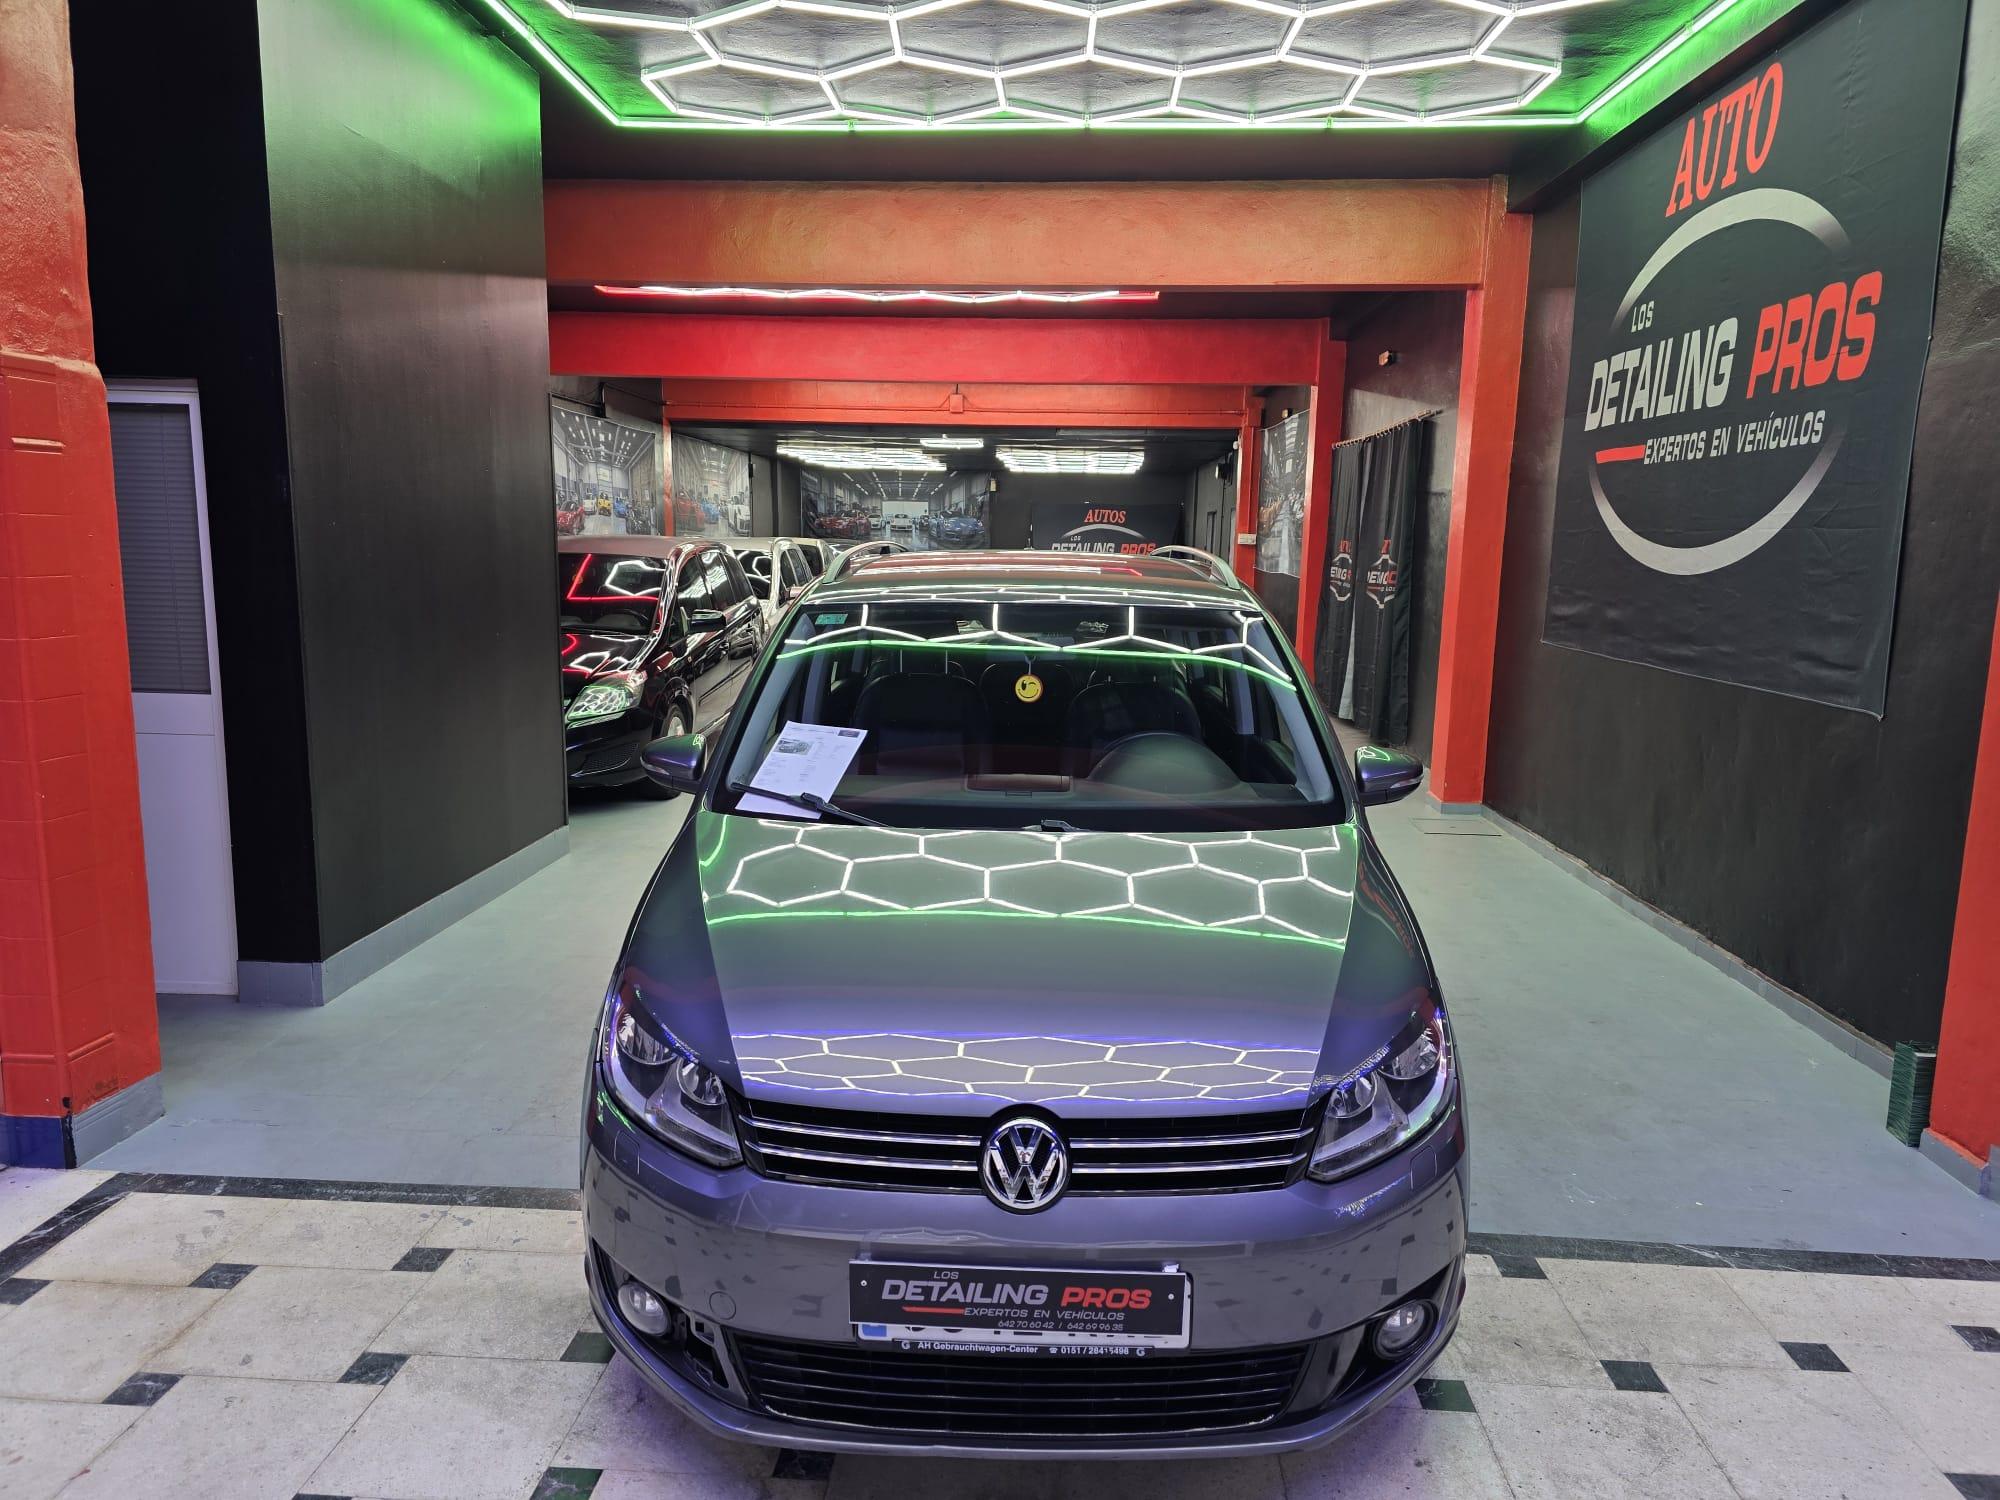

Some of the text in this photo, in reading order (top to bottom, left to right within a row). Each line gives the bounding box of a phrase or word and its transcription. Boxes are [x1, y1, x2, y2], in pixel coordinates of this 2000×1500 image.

[1665, 62, 1784, 217] AUTO
[1631, 301, 1655, 333] LOS
[1584, 270, 1883, 432] DETAILING PROS
[1643, 410, 1826, 465] EXPERTOS EN VEHÍCULOS
[1084, 509, 1127, 523] AUTOS
[933, 1271, 960, 1280] LOS
[881, 1279, 1152, 1309] DETAILING PROS
[963, 1307, 1126, 1320] EXPERTOS EN VEHÍCULOS
[917, 1342, 931, 1350] AH
[933, 1342, 1039, 1353] Gebrauchtwagen-Center
